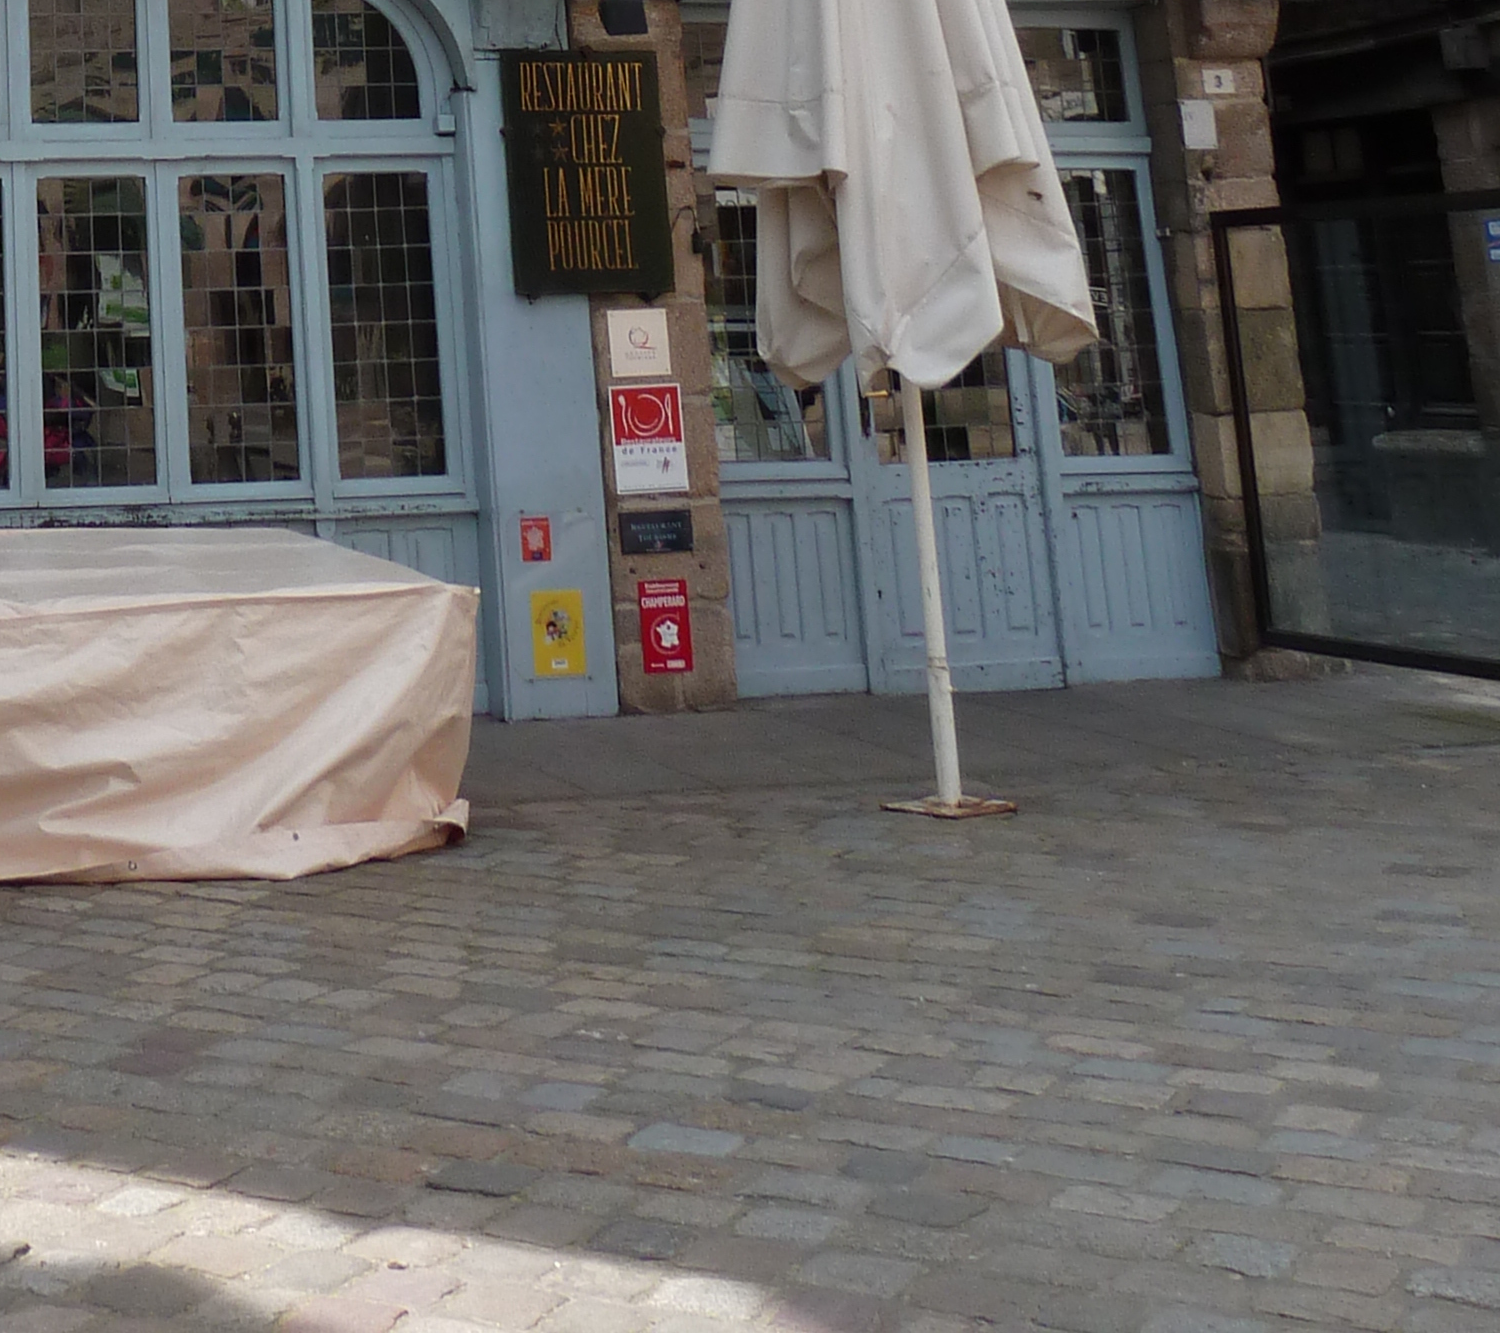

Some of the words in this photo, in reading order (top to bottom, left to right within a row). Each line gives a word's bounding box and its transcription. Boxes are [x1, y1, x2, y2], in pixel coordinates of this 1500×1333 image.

[519, 62, 643, 111] RESTAURANT
[570, 114, 623, 164] CHEZ
[543, 167, 570, 218] LA
[578, 167, 635, 217] MERE
[547, 219, 639, 271] POURCEL
[621, 447, 634, 455] de
[640, 446, 677, 454] France
